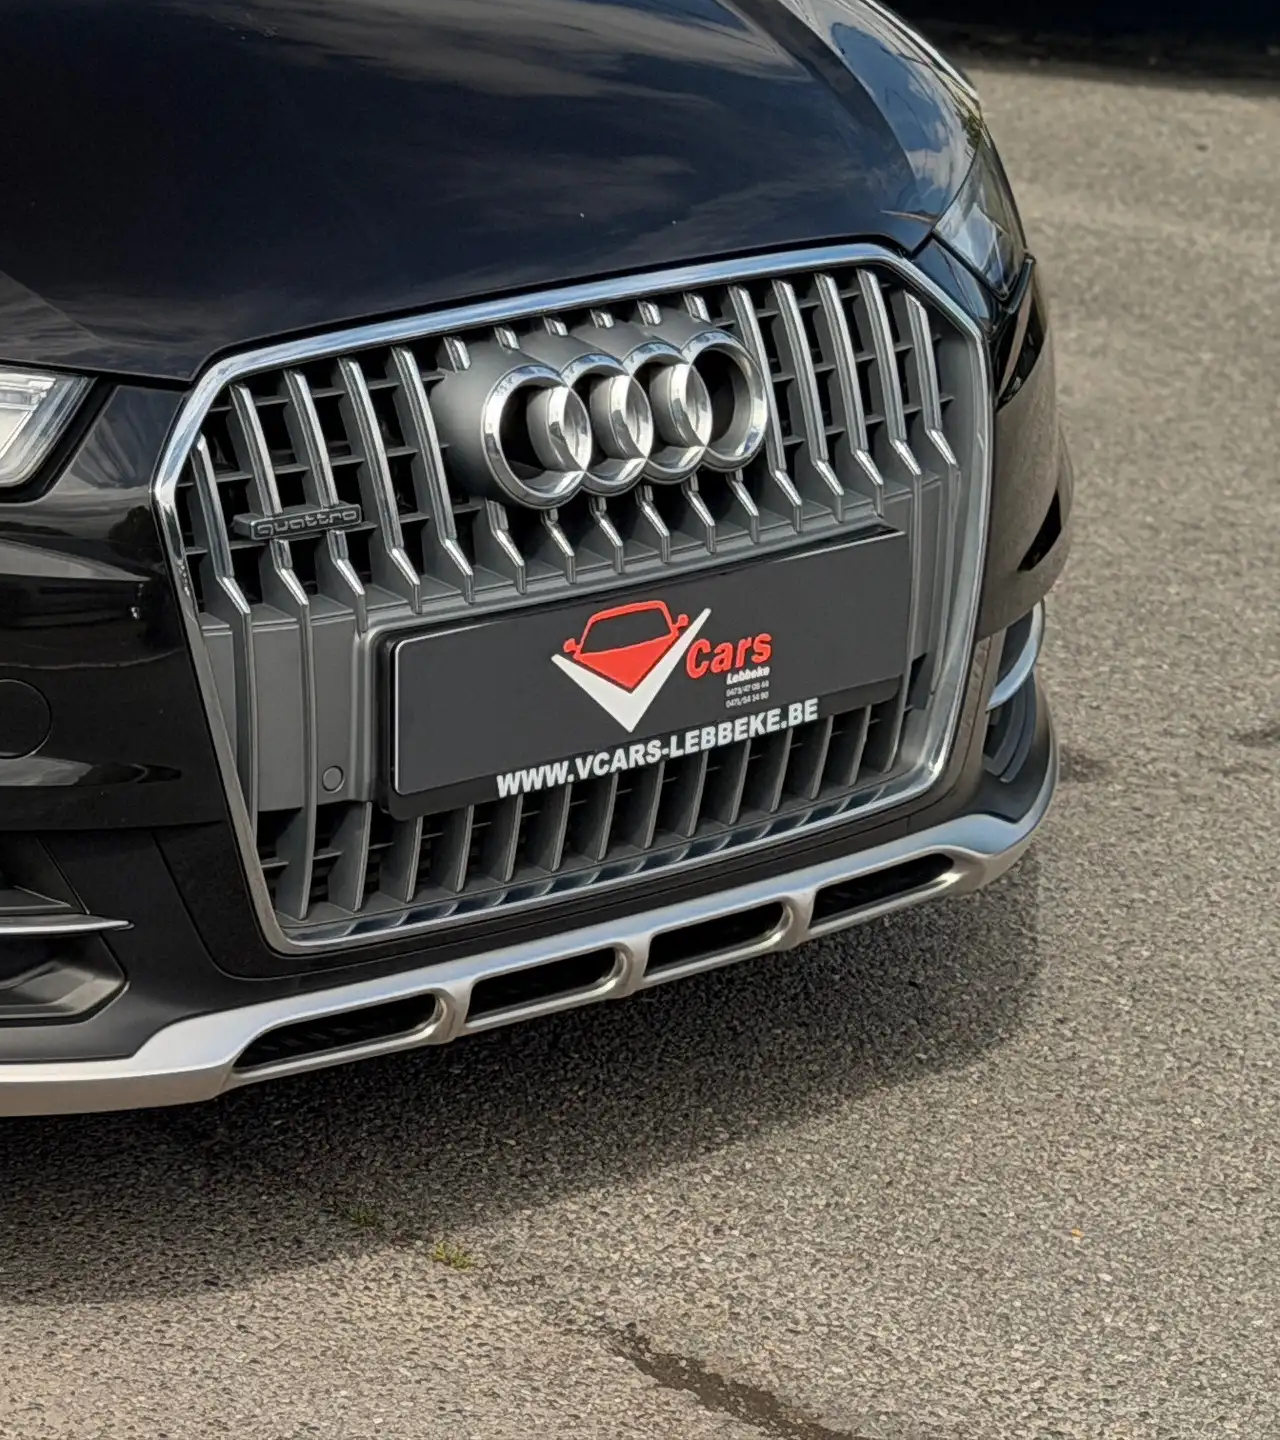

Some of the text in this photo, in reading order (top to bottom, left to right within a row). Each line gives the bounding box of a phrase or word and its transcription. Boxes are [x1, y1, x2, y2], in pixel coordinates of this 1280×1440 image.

[257, 510, 357, 536] quattro
[686, 633, 772, 679] Cars
[726, 665, 770, 685] Lebbeke
[496, 698, 818, 799] WWW.VCARS-LEBBEKE.BE
